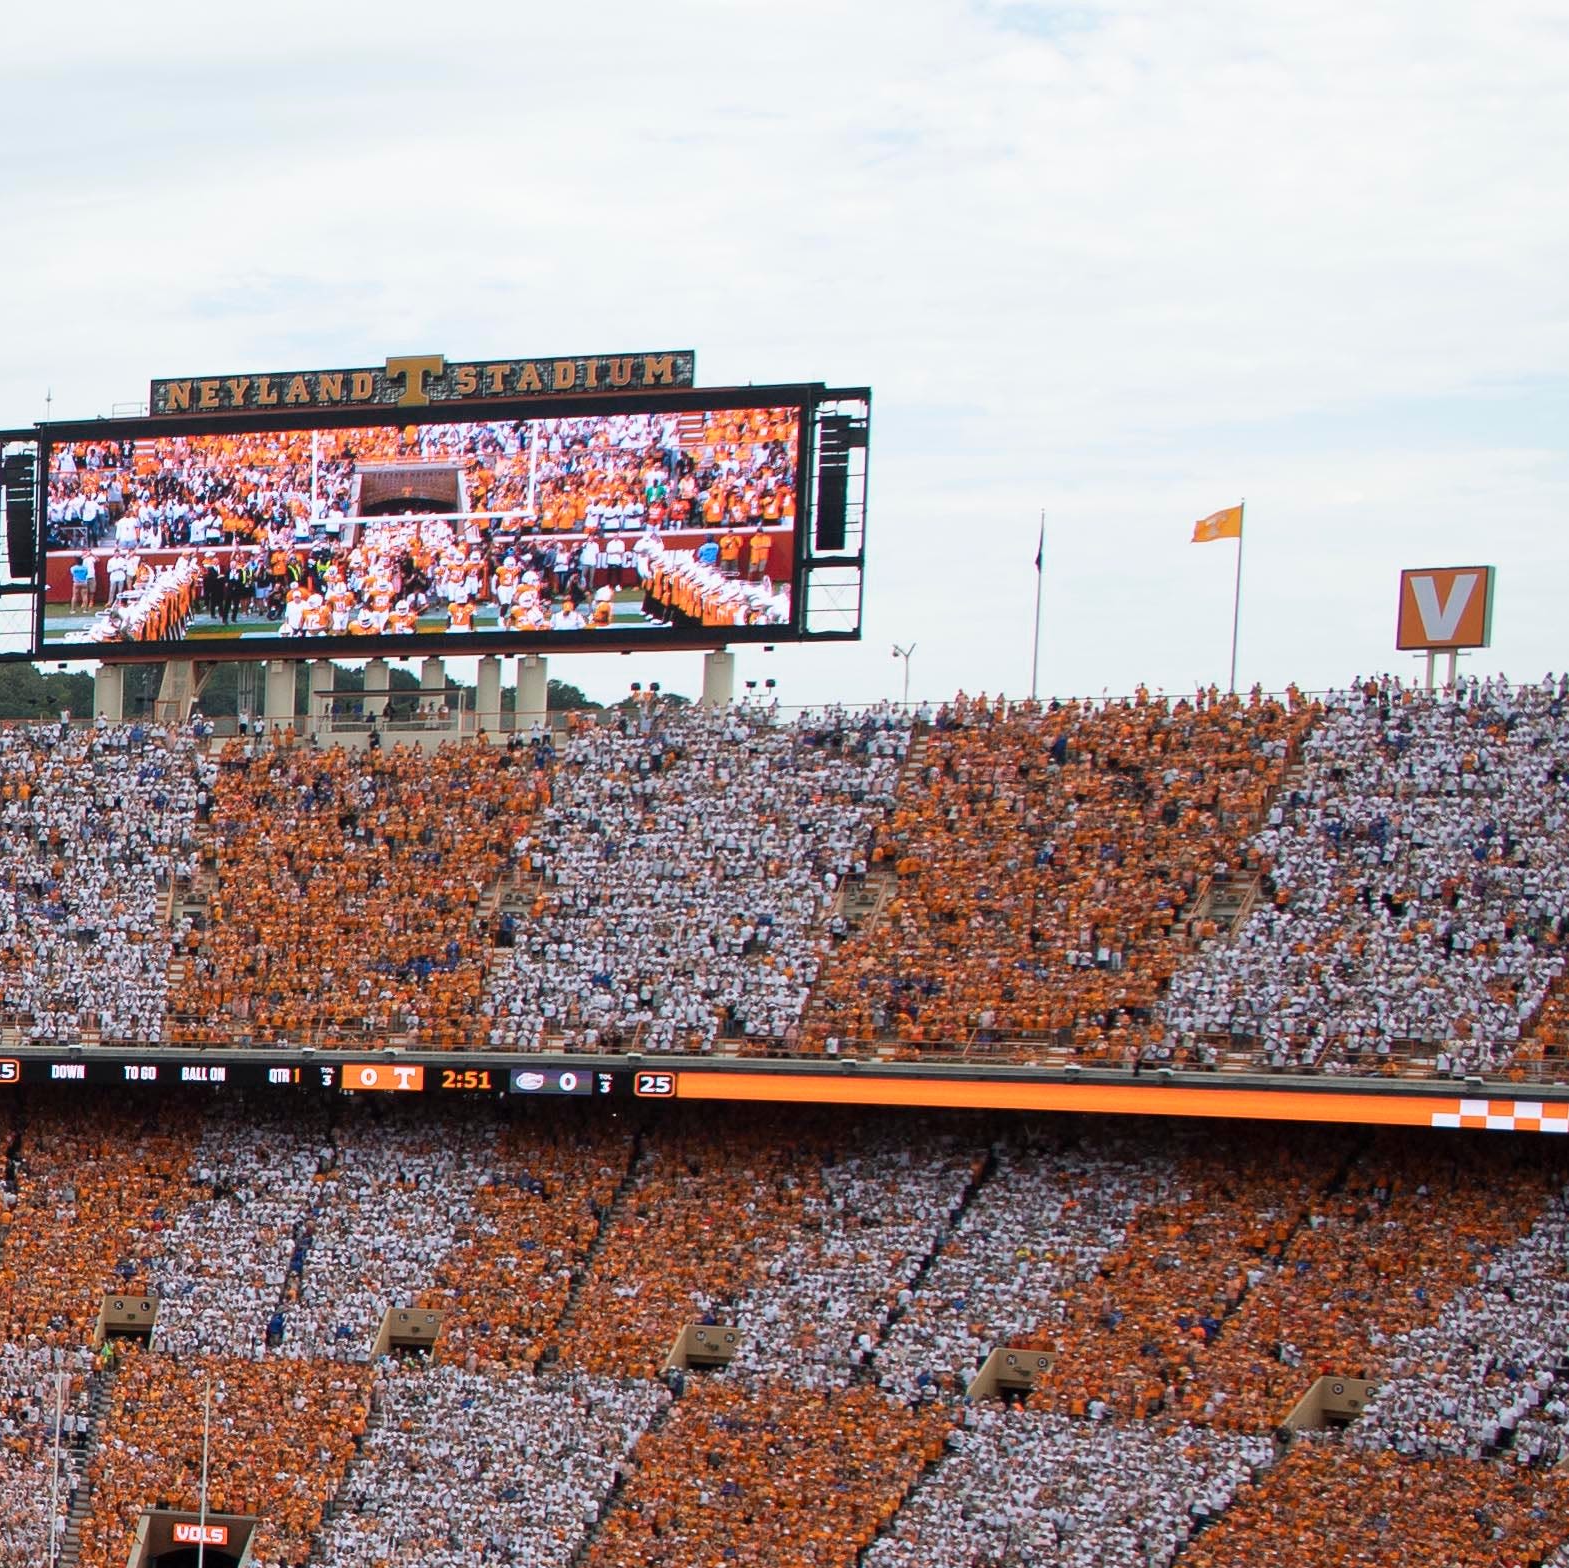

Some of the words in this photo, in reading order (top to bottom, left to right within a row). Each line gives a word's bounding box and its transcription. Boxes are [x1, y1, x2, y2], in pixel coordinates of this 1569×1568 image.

[167, 373, 373, 410] NEYLAND
[457, 357, 673, 394] STADIUM
[1410, 574, 1479, 641] V
[51, 1065, 85, 1079] DOWN
[125, 1066, 139, 1079] TO
[140, 1066, 157, 1079] GO
[182, 1067, 207, 1081] BALL
[209, 1067, 225, 1081] ON
[269, 1067, 290, 1083] QTR
[293, 1068, 300, 1083] 1
[322, 1074, 332, 1086] 3
[360, 1068, 378, 1086] 0
[442, 1071, 491, 1089] 2:51
[559, 1072, 576, 1091] 0
[600, 1081, 611, 1093] 3
[639, 1076, 670, 1093] 25
